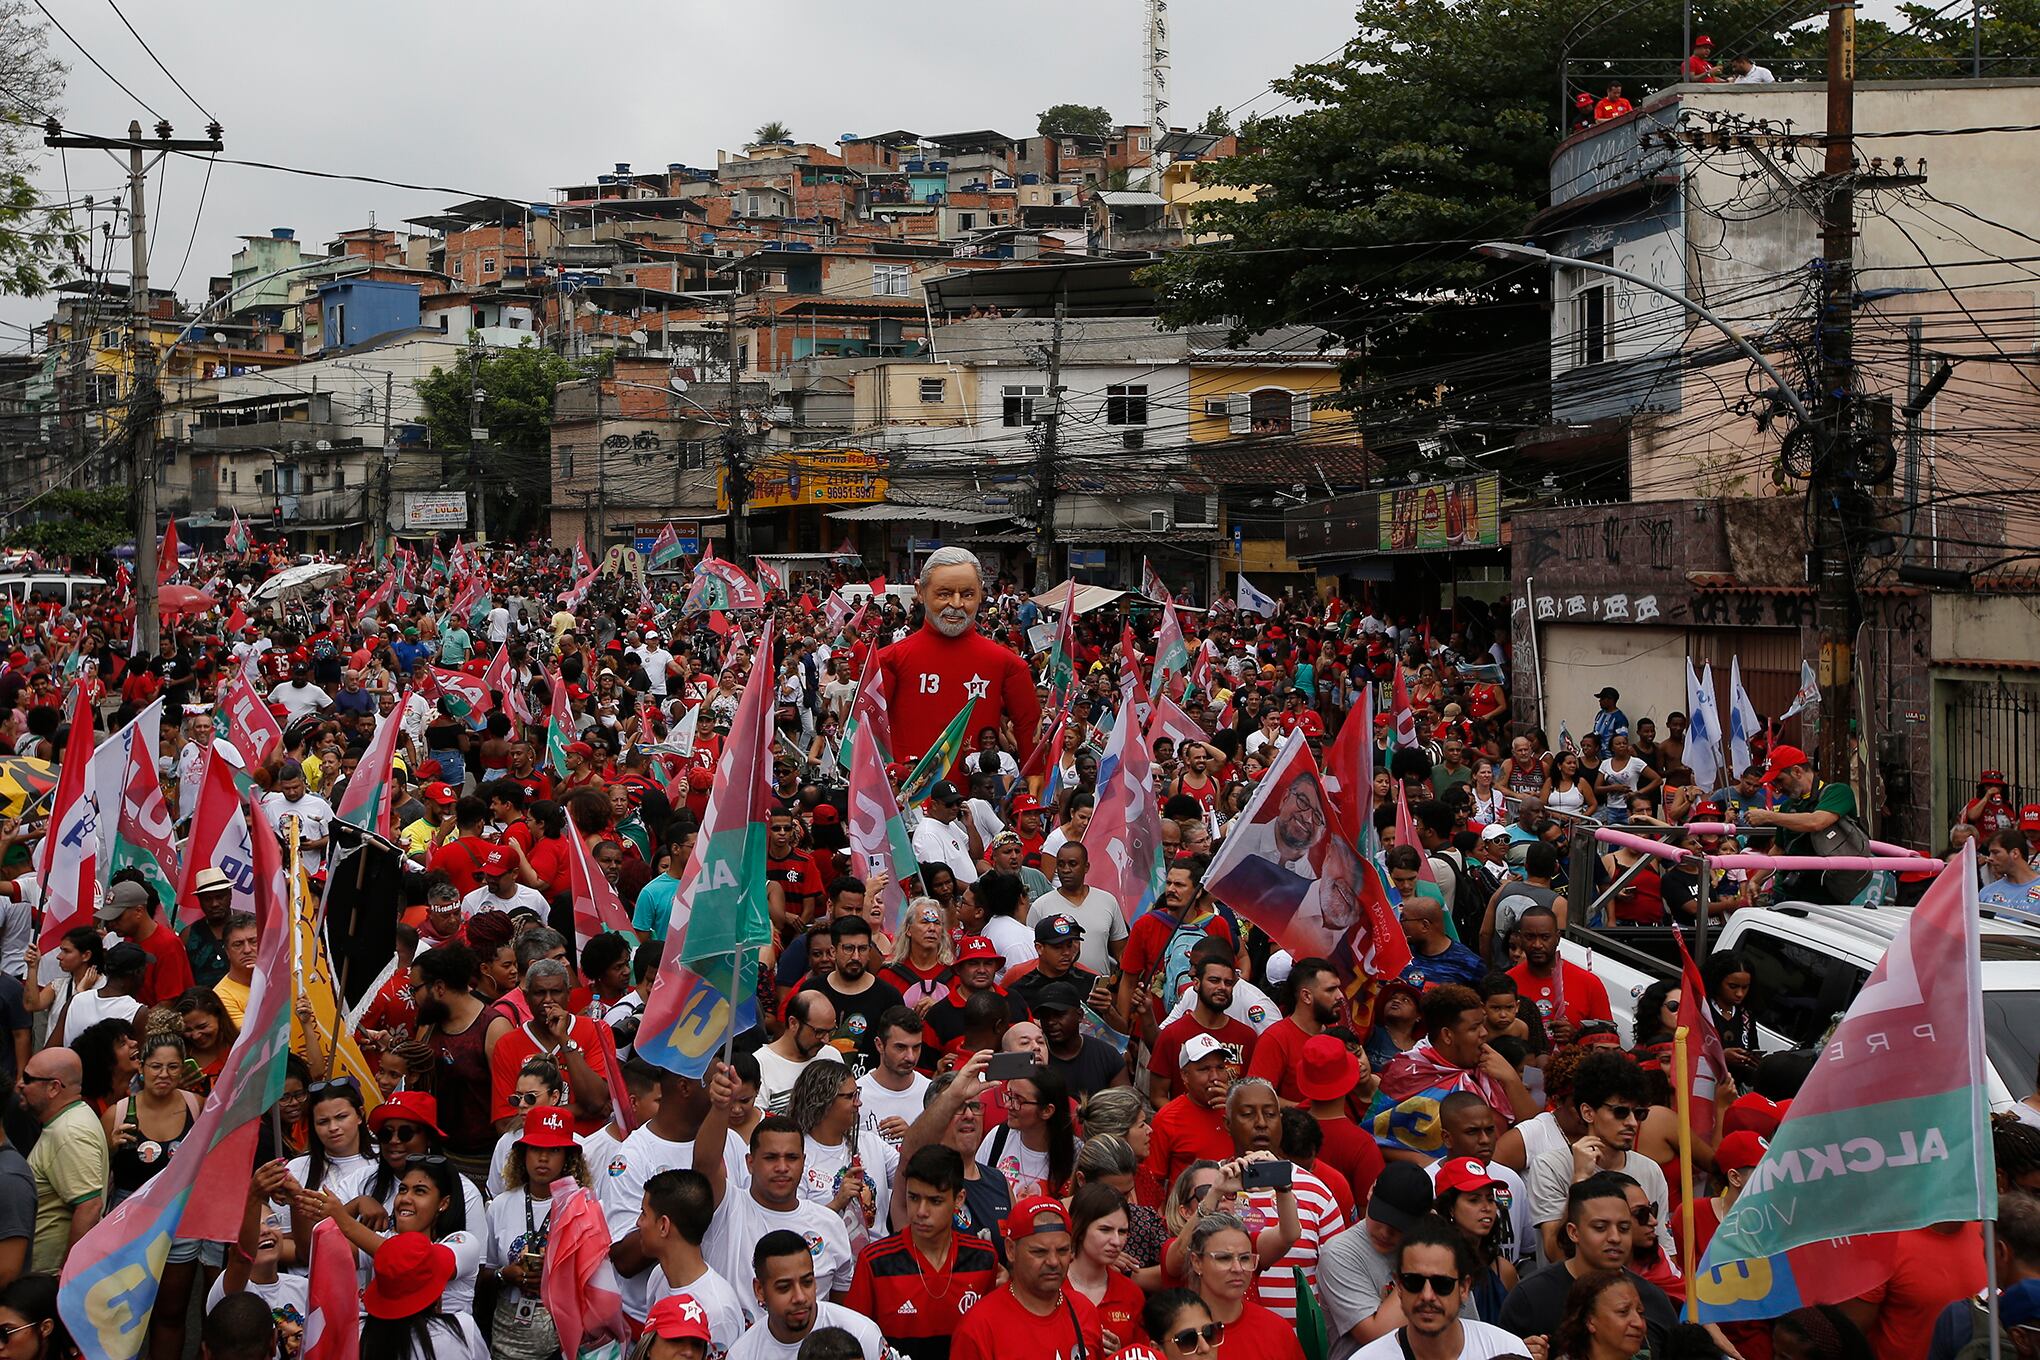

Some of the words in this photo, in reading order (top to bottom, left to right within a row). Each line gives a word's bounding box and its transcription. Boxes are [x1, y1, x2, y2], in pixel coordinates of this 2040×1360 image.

[919, 673, 940, 694] 13
[970, 681, 985, 694] PT
[1905, 712, 1919, 720] LULA
[969, 941, 987, 950] LULA
[542, 1116, 563, 1129] LULA
